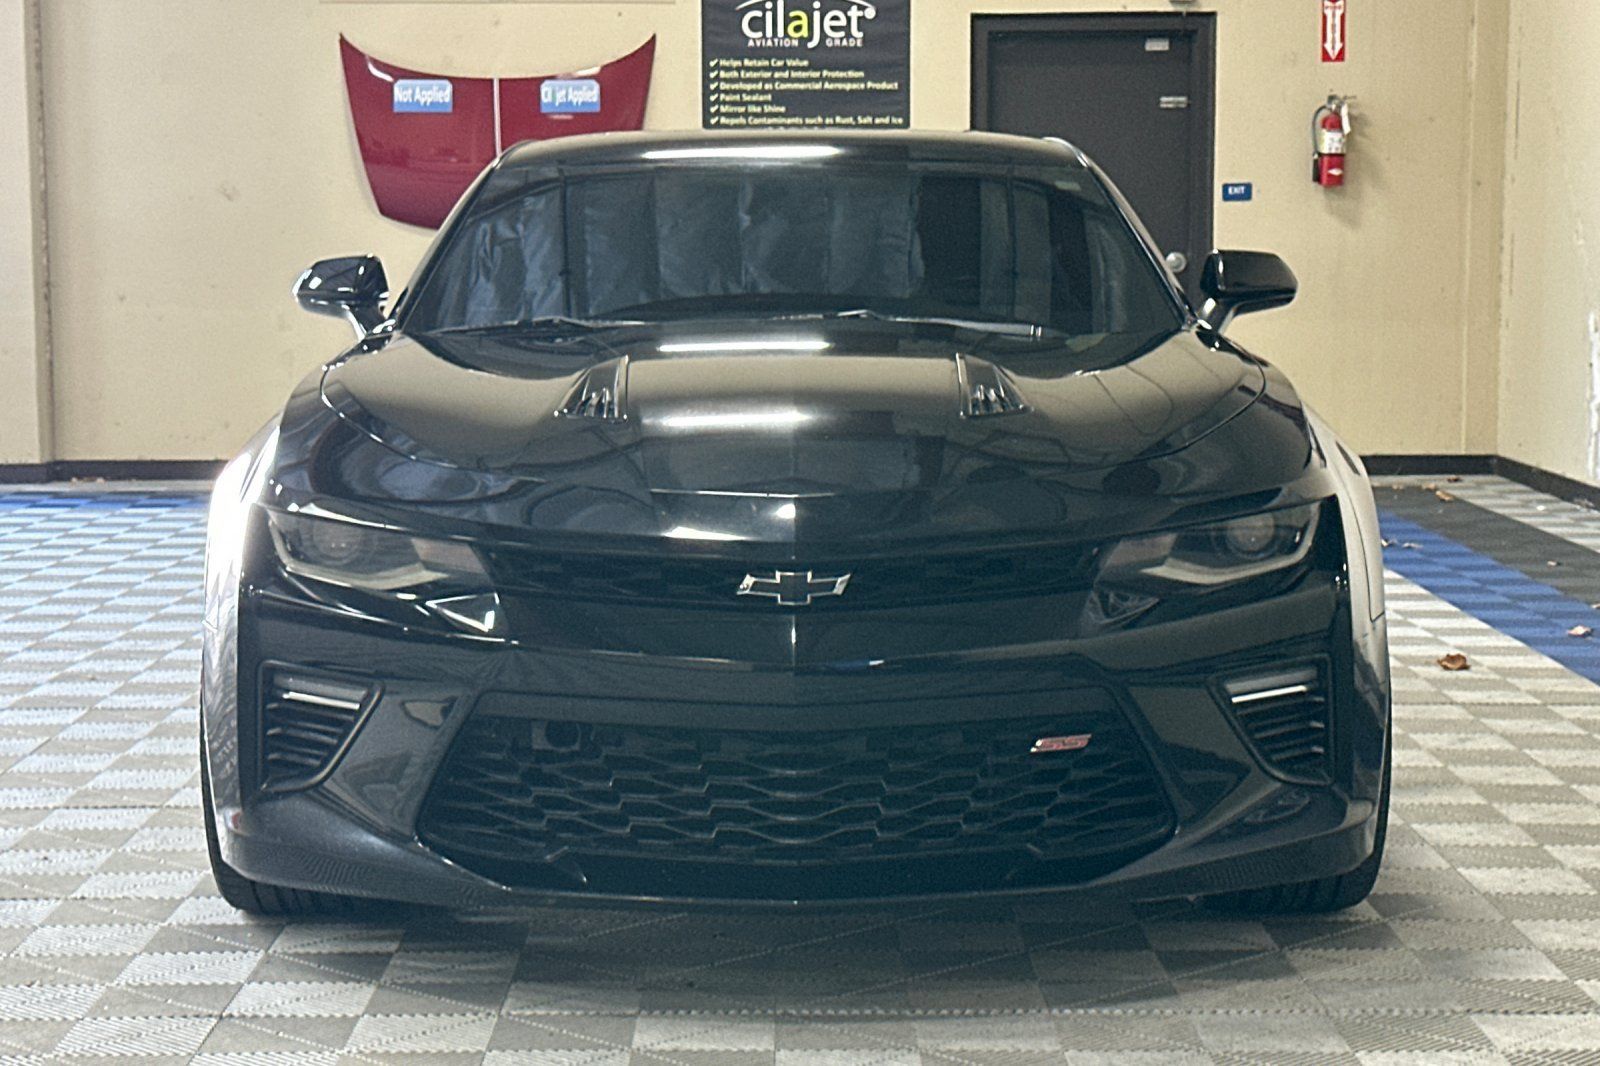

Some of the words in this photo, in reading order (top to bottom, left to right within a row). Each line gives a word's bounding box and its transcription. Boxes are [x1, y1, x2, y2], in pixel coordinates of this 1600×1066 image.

[742, 0, 864, 48] cilajet
[747, 38, 799, 47] AVIATION
[826, 38, 864, 47] GRADE
[720, 58, 742, 68] Helps
[743, 58, 769, 67] Retain
[771, 58, 785, 67] Car
[786, 58, 809, 67] Value
[720, 70, 739, 78] Both
[741, 70, 772, 78] Exterior
[773, 70, 789, 78] and
[790, 70, 821, 78] Interior
[822, 70, 865, 78] Protection
[720, 82, 763, 91] Developed
[774, 82, 823, 90] Commercial
[823, 81, 866, 91] Aerospace
[866, 81, 899, 90] Product
[394, 86, 413, 103] Not
[414, 85, 451, 106] Applied
[567, 85, 599, 106] Applied
[720, 93, 741, 102] Paint
[742, 93, 772, 102] Sealant
[720, 105, 747, 113] Mirror
[763, 105, 787, 113] Shine
[748, 116, 803, 124] Contaminants
[804, 116, 823, 124] such
[857, 116, 873, 124] Salt
[874, 116, 890, 124] and
[891, 116, 904, 124] Ice
[1228, 185, 1245, 195] EXIT
